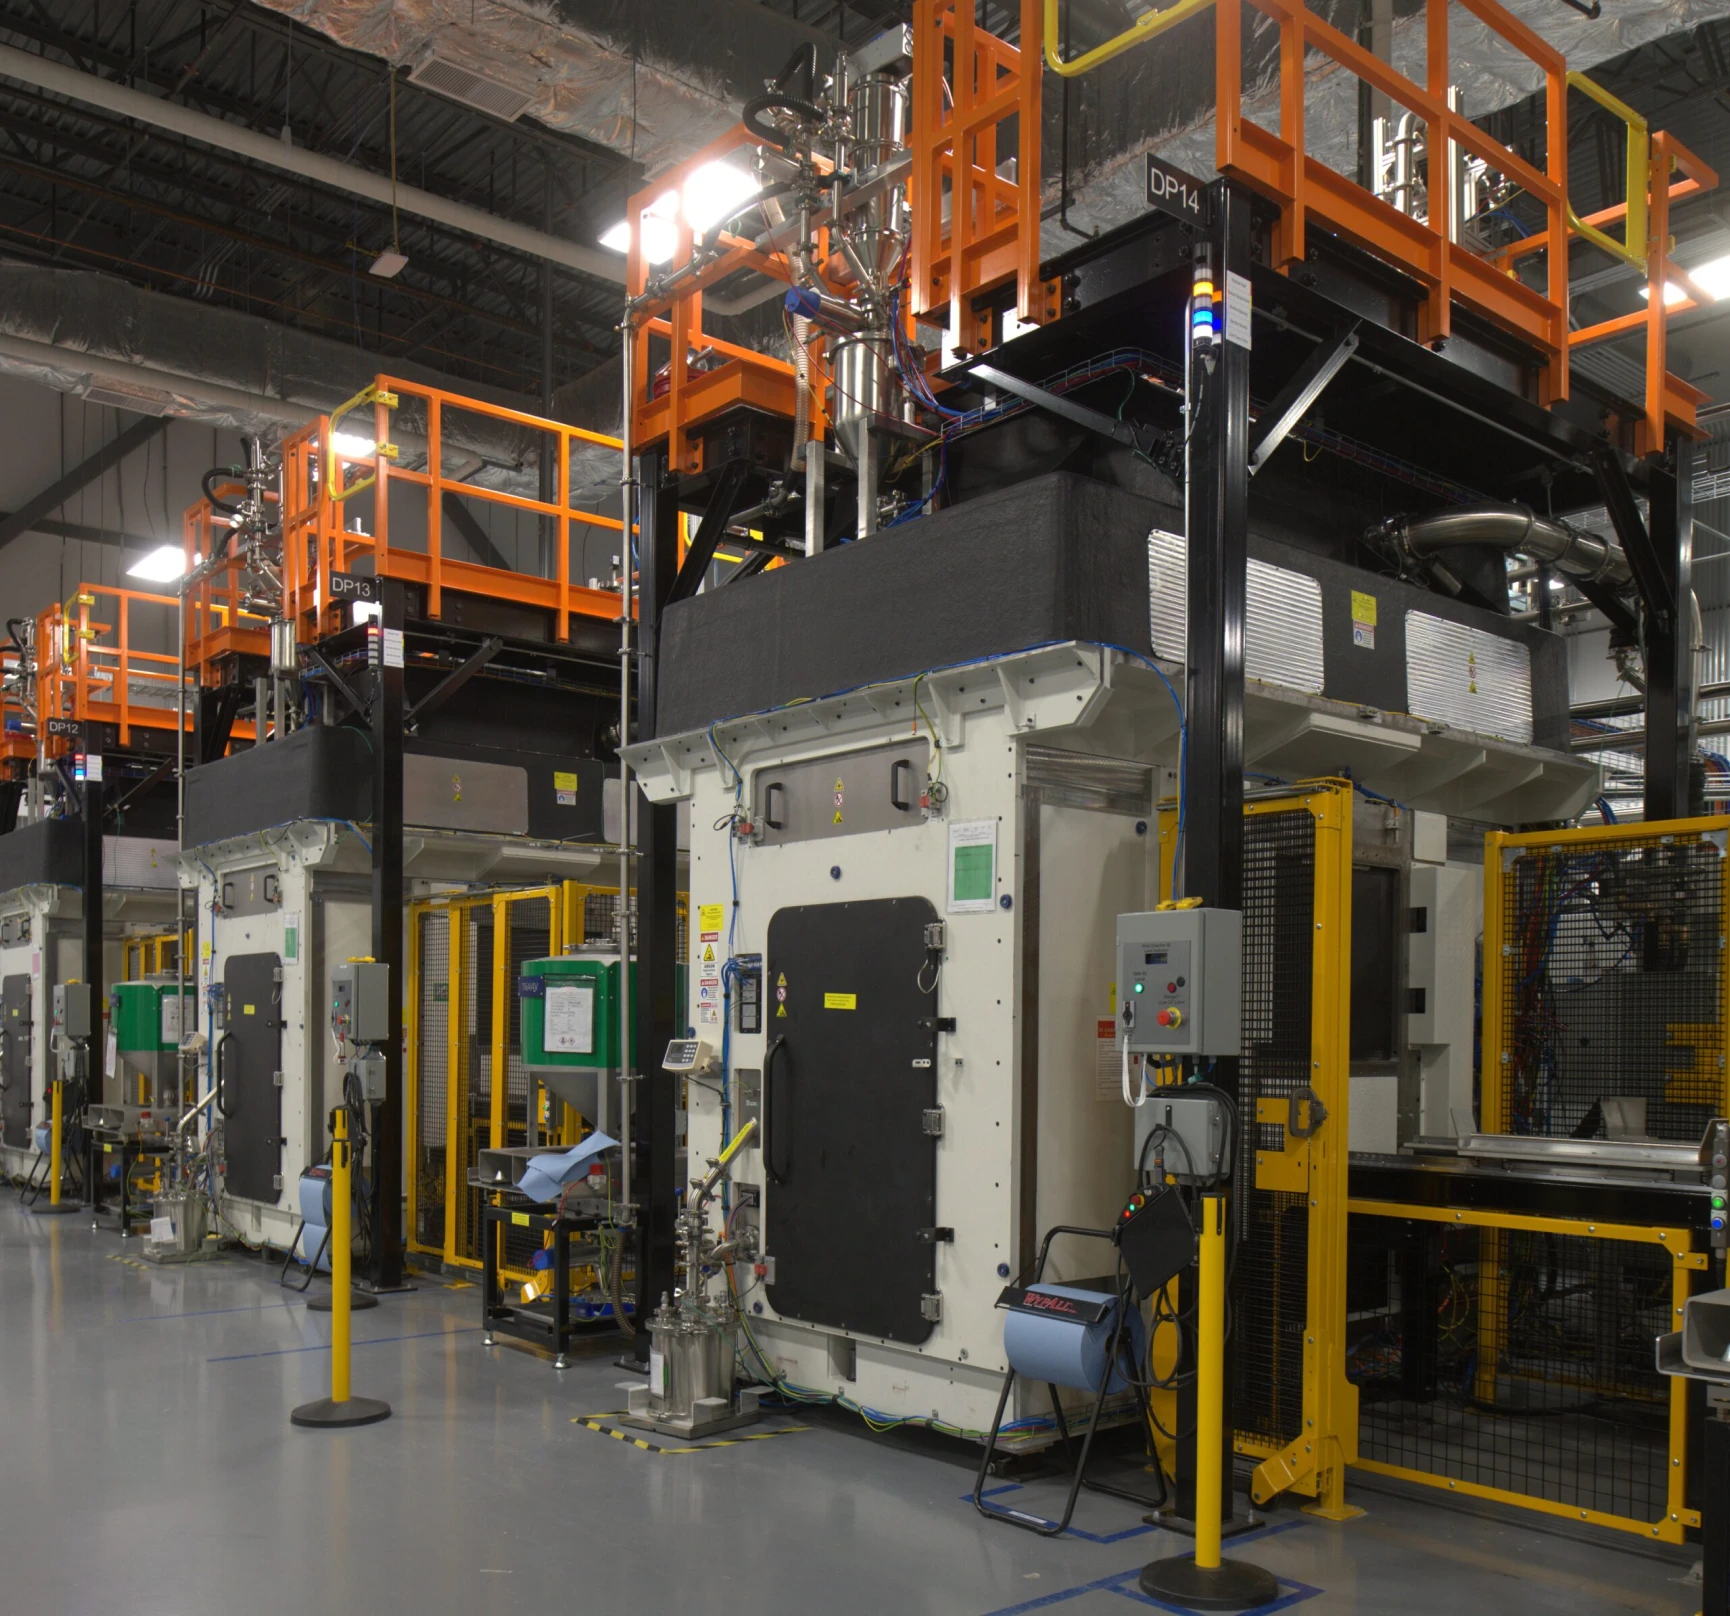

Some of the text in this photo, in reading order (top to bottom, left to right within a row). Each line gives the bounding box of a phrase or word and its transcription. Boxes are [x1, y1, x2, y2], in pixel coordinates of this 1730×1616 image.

[1151, 167, 1200, 214] DP14
[332, 577, 371, 597] DP13
[49, 721, 79, 734] DP12
